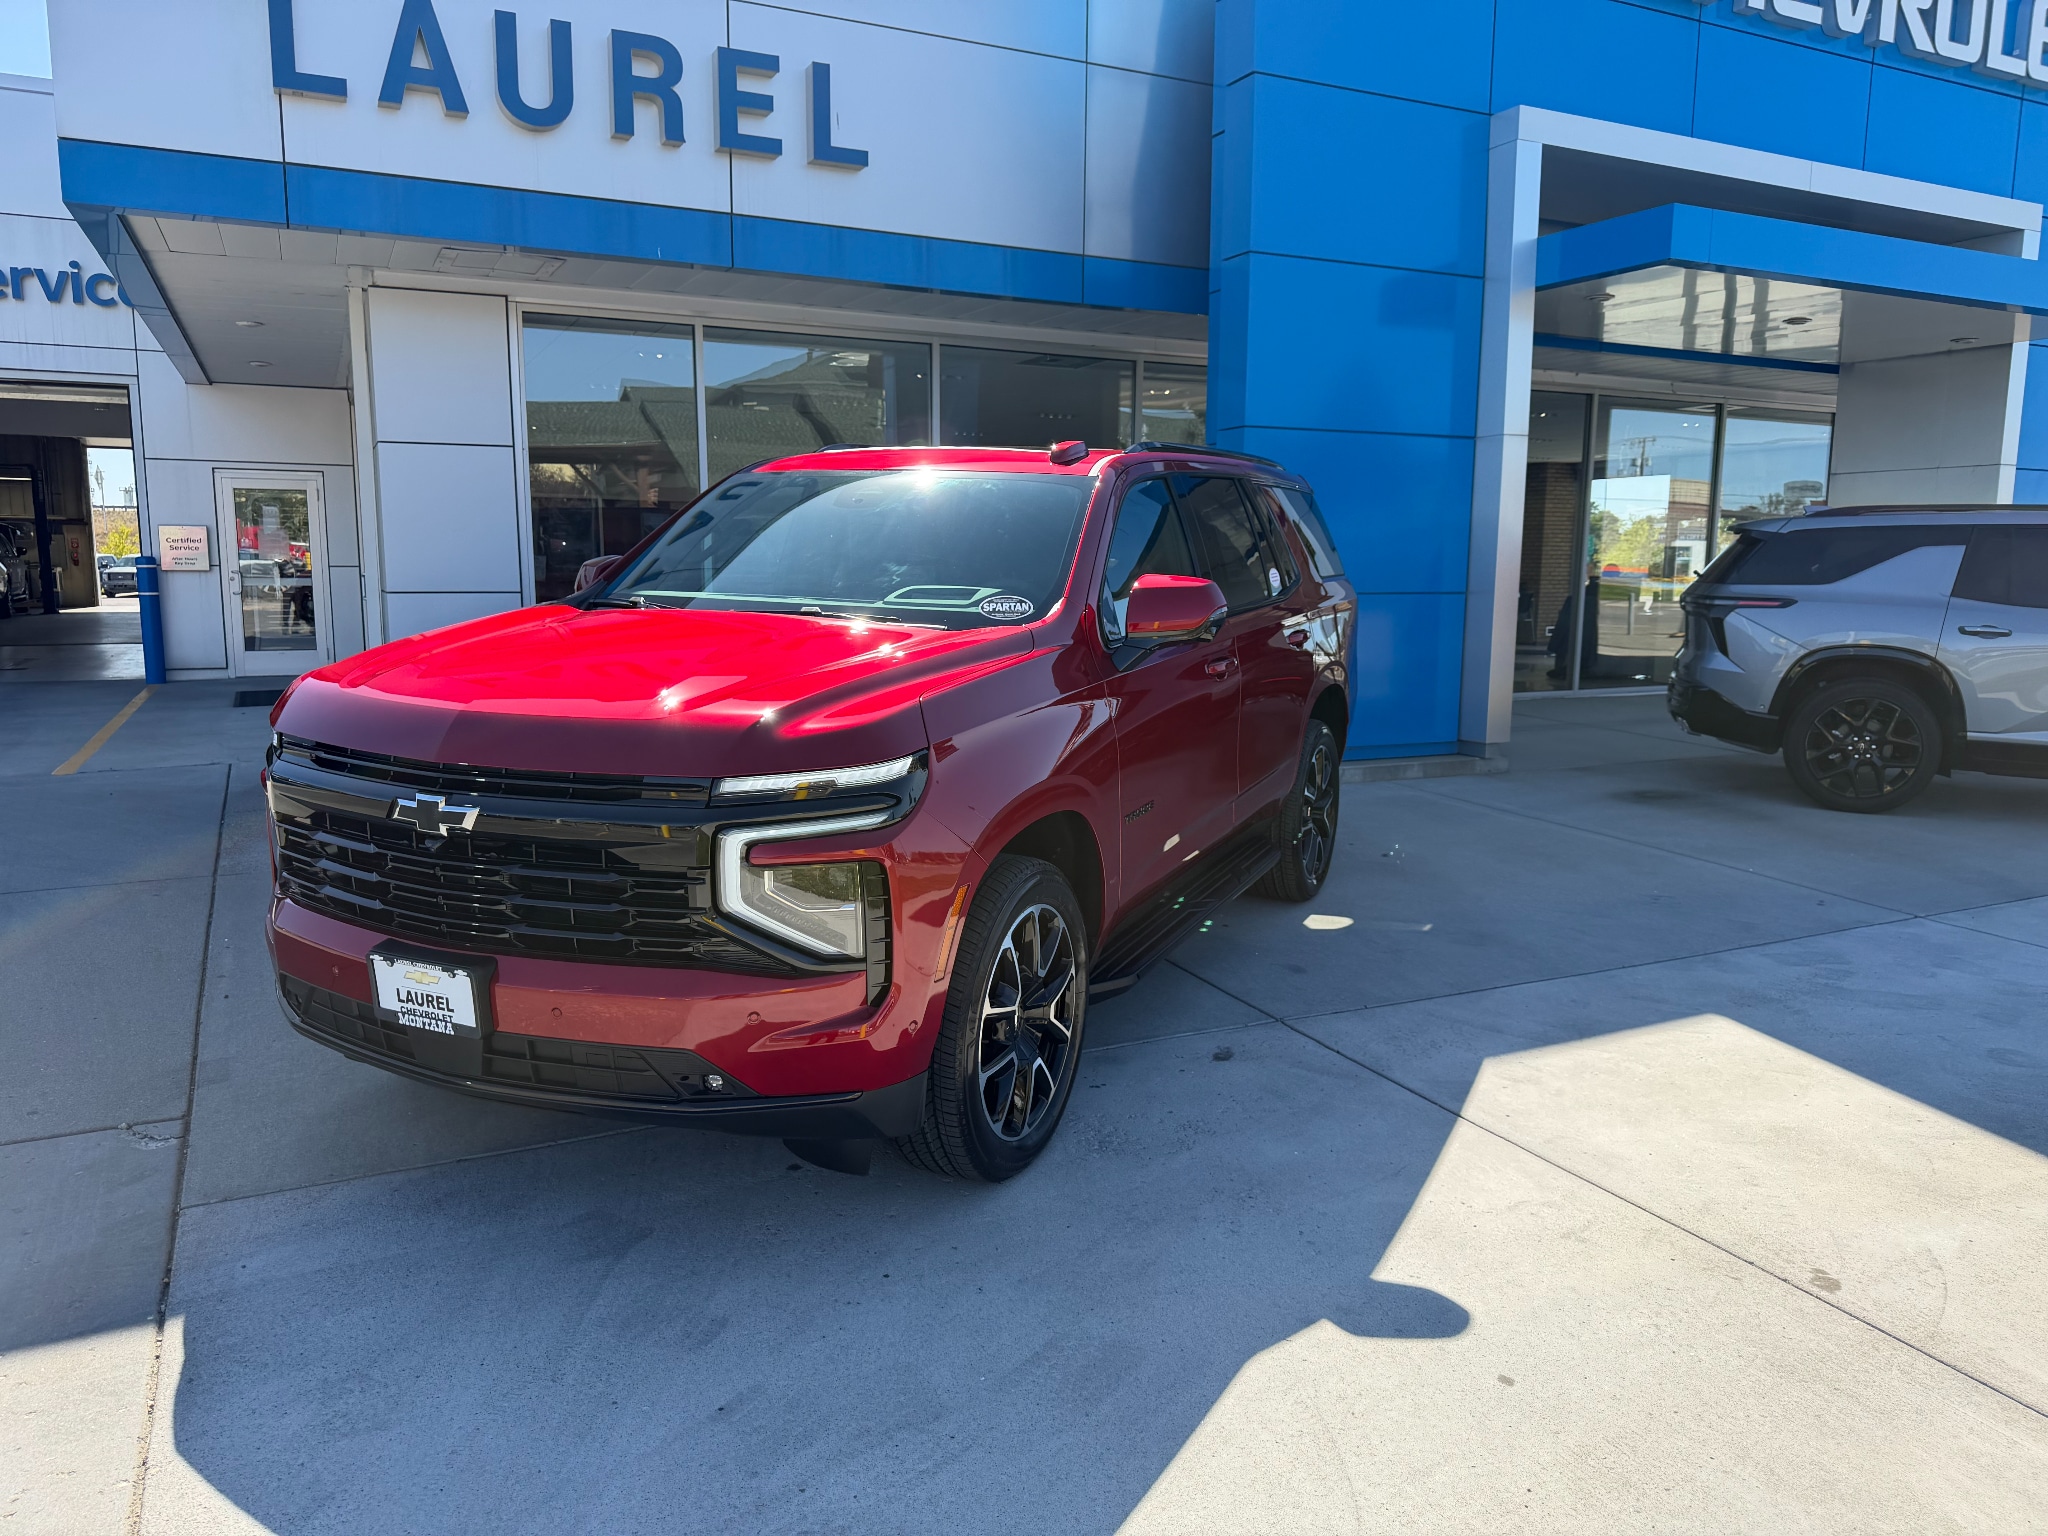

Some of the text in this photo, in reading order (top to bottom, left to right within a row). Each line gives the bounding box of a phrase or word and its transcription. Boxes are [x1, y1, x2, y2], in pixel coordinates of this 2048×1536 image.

[268, 0, 868, 170] LAUREL
[0, 260, 136, 308] rvic
[982, 602, 1029, 612] SPARTAN
[396, 987, 455, 1013] LAUREL
[397, 1012, 455, 1036] MONTANA
[400, 1005, 454, 1023] CHEVROLET
